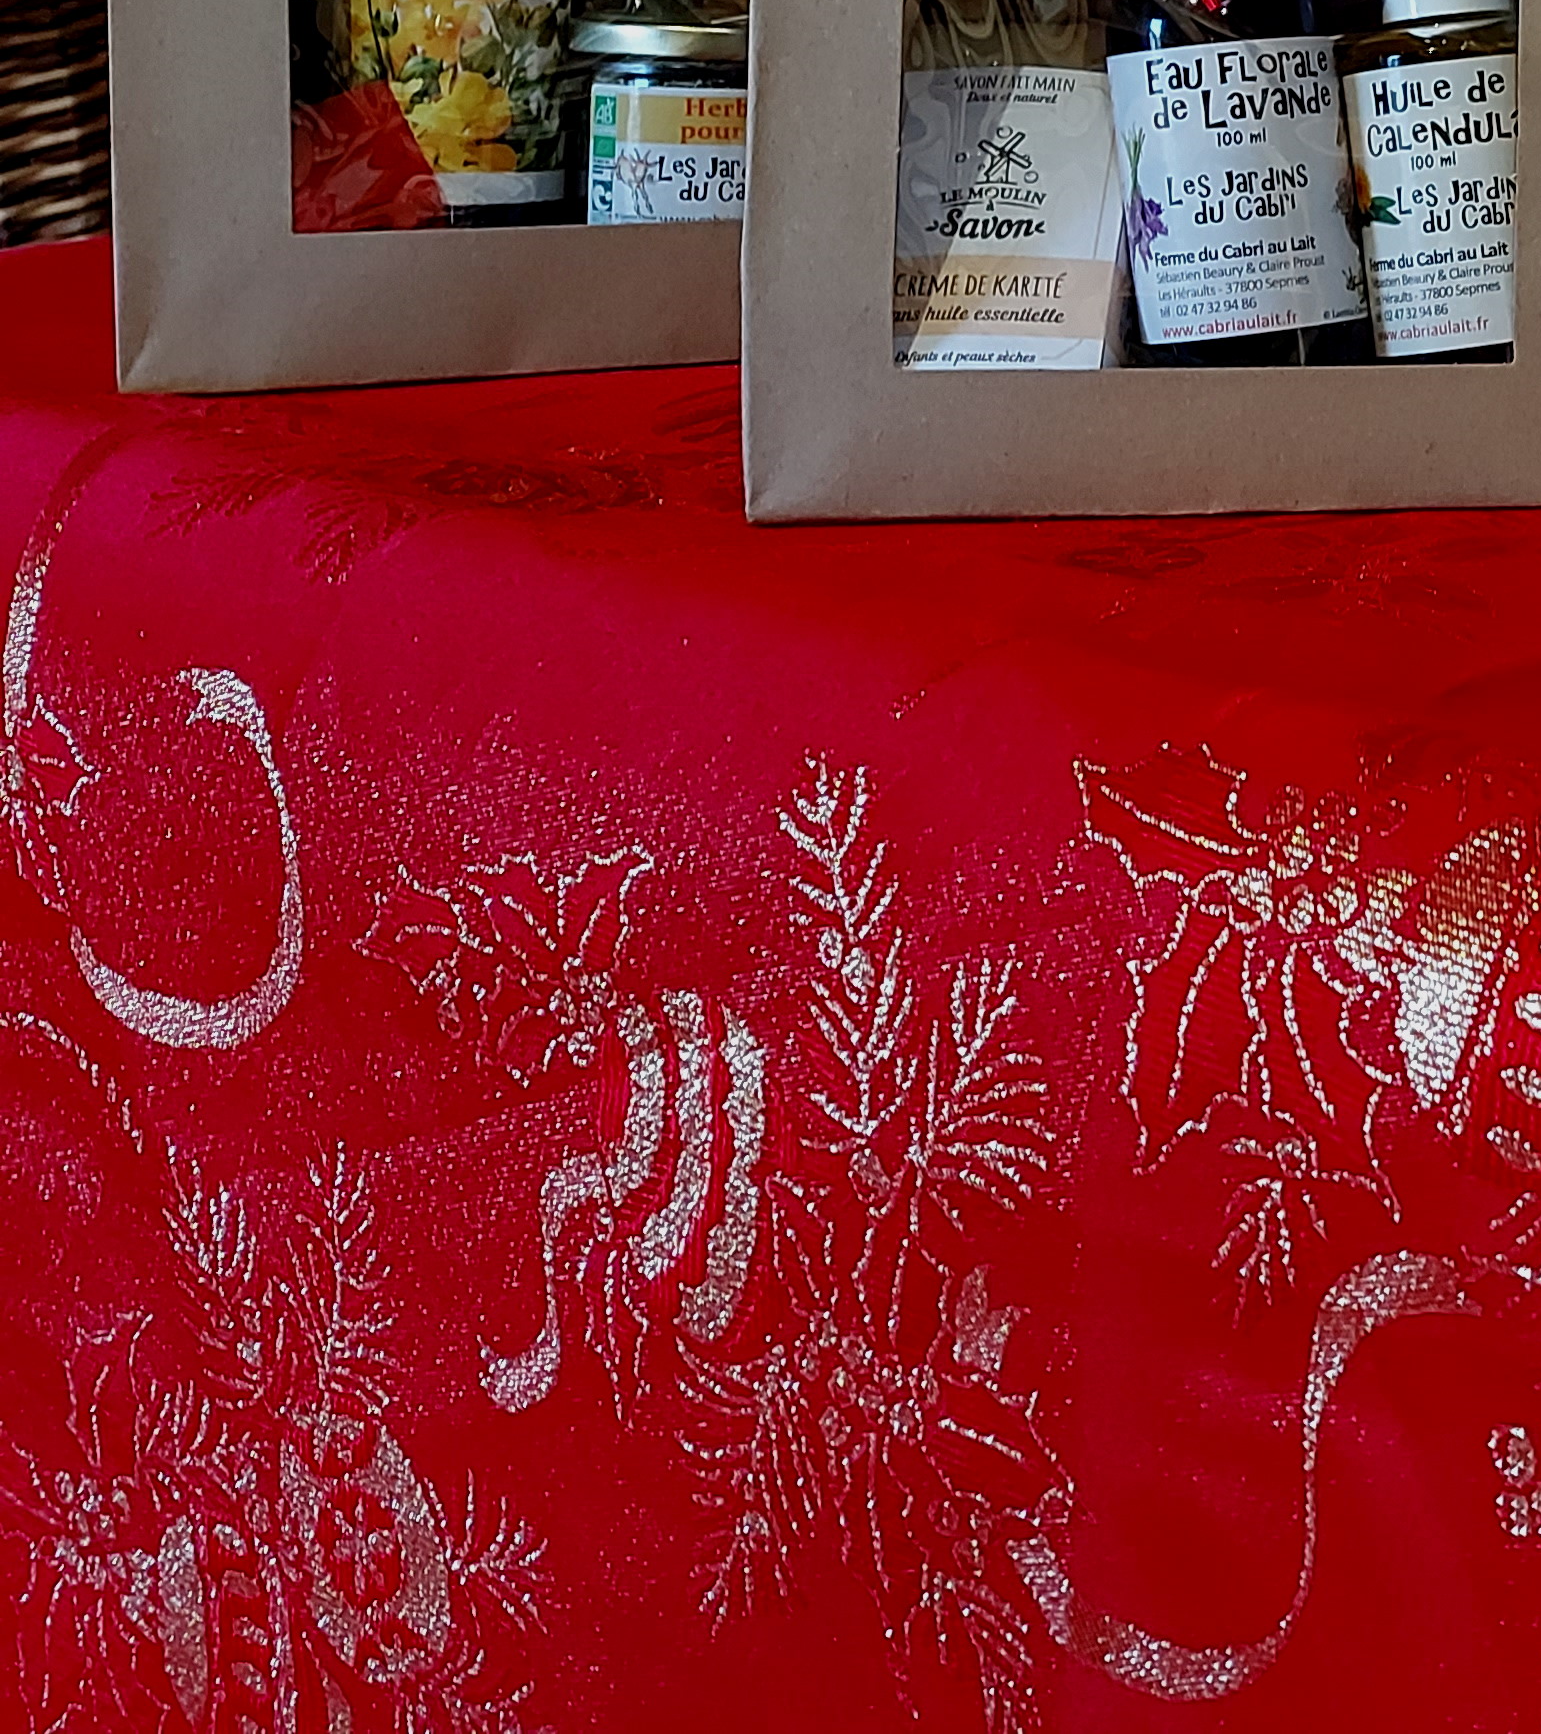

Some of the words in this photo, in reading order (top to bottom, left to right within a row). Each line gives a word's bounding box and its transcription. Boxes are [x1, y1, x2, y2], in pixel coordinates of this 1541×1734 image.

[954, 75, 998, 91] SAVON
[1033, 76, 1076, 93] MAIN
[1467, 70, 1505, 102] de
[1013, 92, 1058, 105] naturel
[1153, 97, 1188, 129] de
[1217, 131, 1243, 147] 100
[1250, 127, 1266, 144] ml
[1410, 153, 1434, 171] 100
[1440, 151, 1456, 166] ml
[968, 186, 1047, 206] MOULIN
[940, 208, 1033, 240] Savon
[1155, 251, 1195, 267] Ferme
[1198, 246, 1219, 263] du
[1223, 240, 1264, 259] Cabri
[1268, 240, 1287, 254] au
[1291, 235, 1316, 251] Lait
[1398, 254, 1413, 269] du
[1417, 247, 1454, 267] Cabri
[1458, 248, 1477, 261] au
[1481, 241, 1509, 258] Lait
[1259, 258, 1290, 272] Claire
[964, 274, 987, 296] DE
[992, 272, 1068, 299] KARITÉ
[1225, 279, 1263, 294] 37800
[1421, 286, 1453, 300] 37800
[1455, 281, 1500, 297] Sepmes
[924, 306, 969, 323] huile
[973, 307, 1066, 324] essentielle
[1207, 301, 1221, 313] 32
[1223, 299, 1239, 312] 94
[1162, 310, 1297, 339] www.cabriaulait.fr
